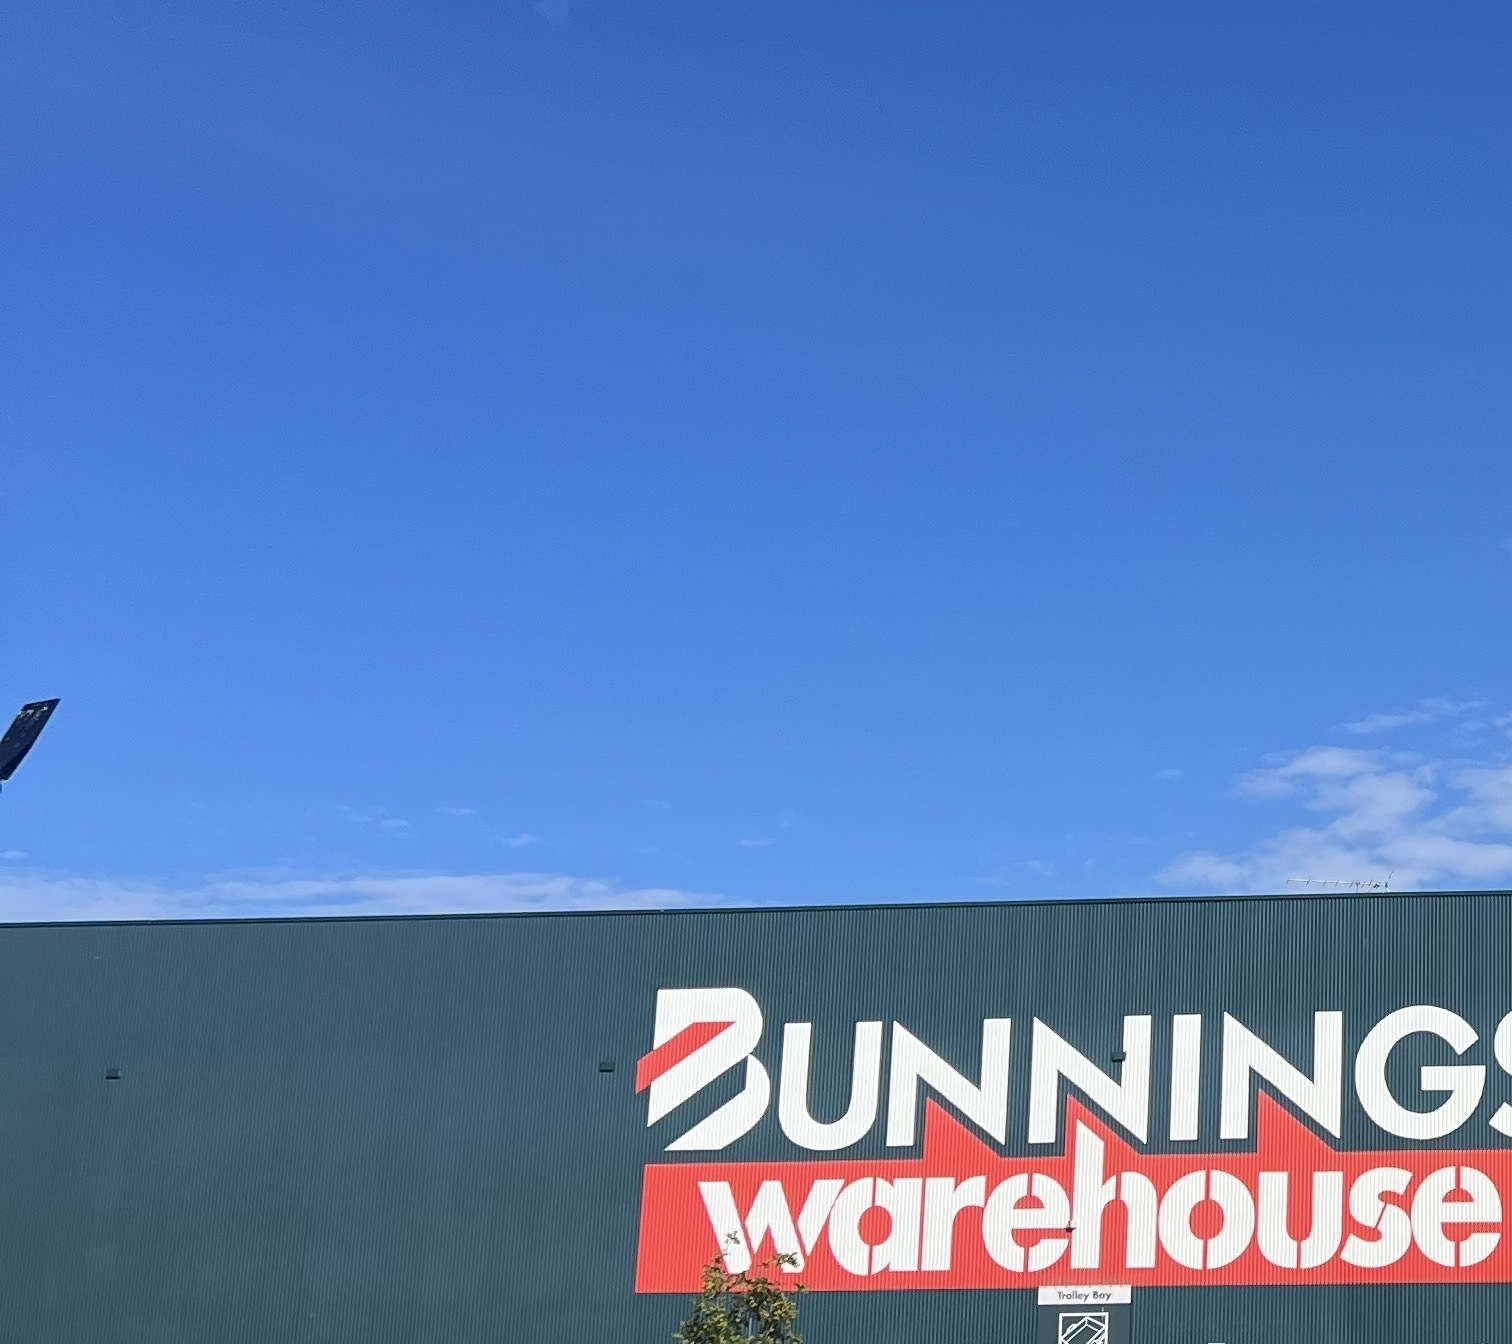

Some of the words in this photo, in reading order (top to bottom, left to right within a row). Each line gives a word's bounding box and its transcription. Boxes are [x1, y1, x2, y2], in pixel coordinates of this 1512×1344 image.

[697, 1119, 1503, 1277] warehouse
[1057, 1290, 1090, 1302] Trolley
[1093, 1290, 1111, 1302] Bay
